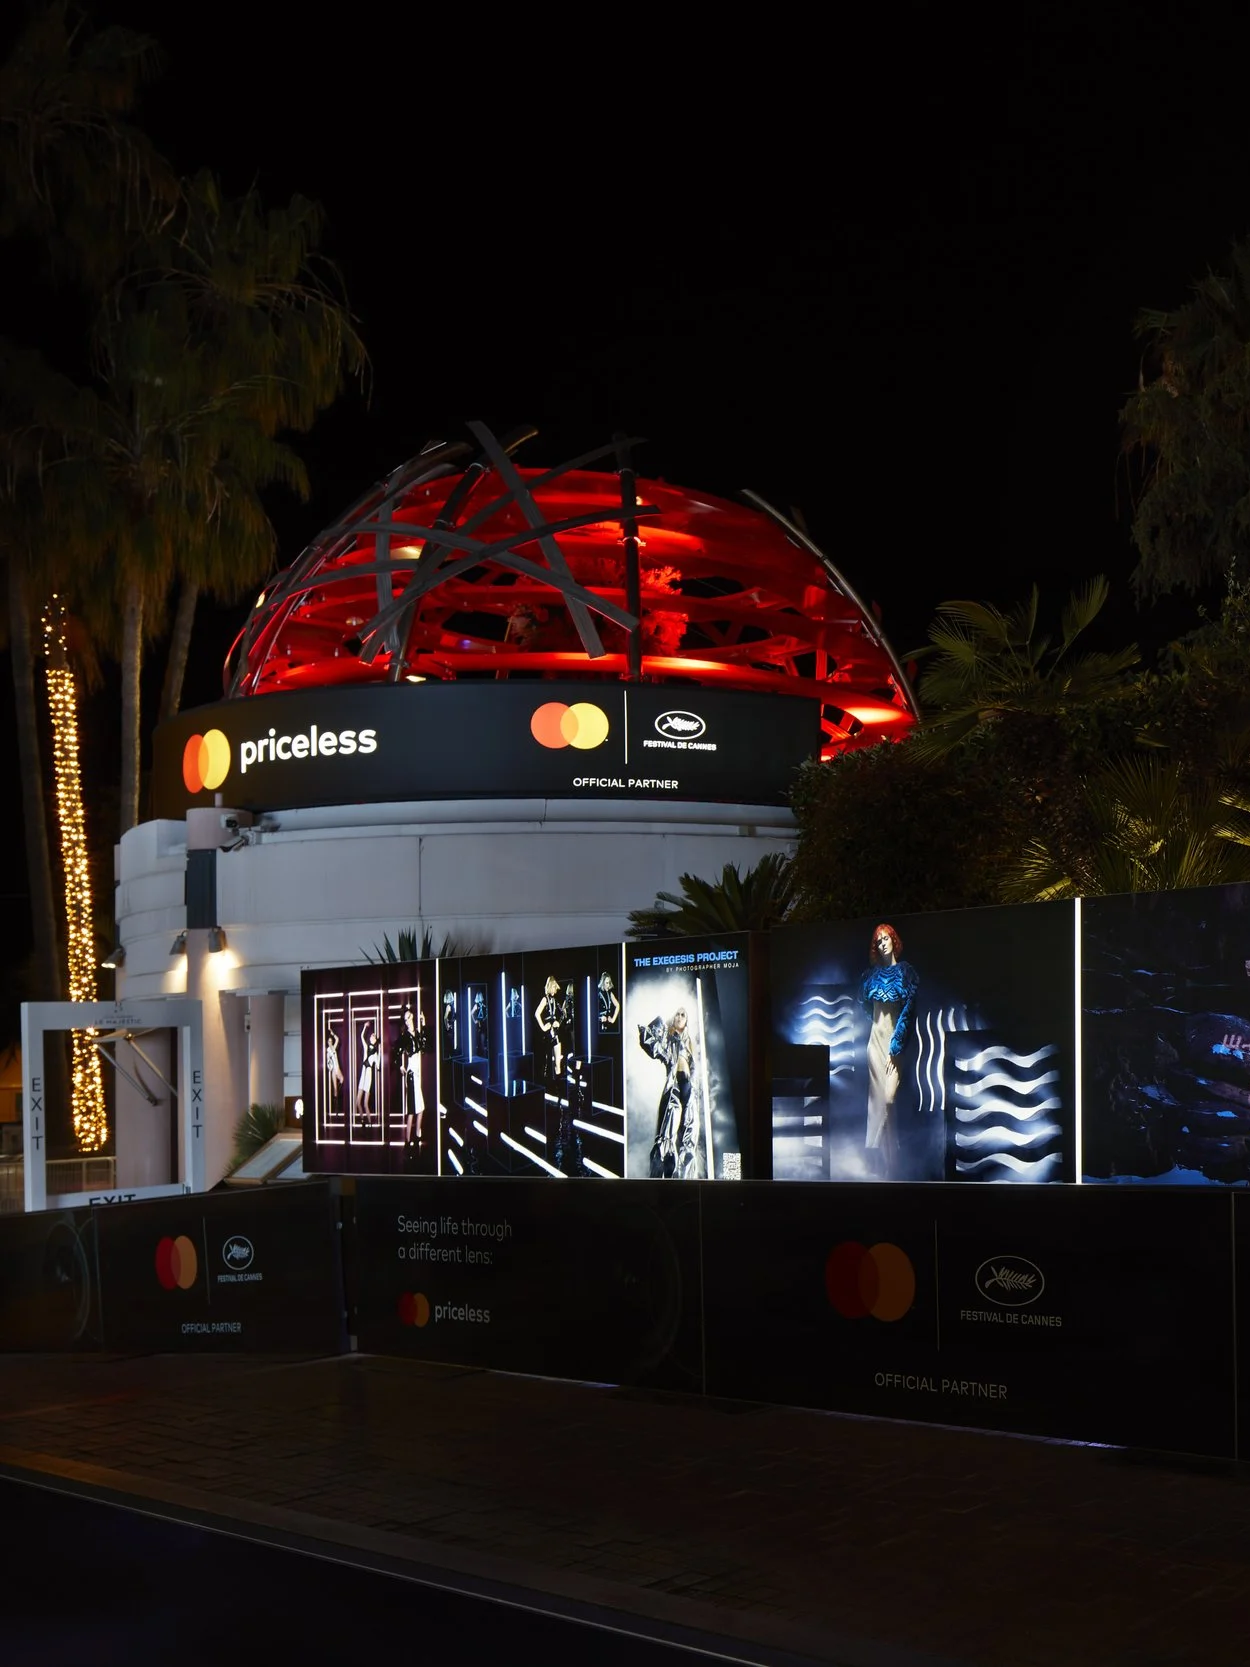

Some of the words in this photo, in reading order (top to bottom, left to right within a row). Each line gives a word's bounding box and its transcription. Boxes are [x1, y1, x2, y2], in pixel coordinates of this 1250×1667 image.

[240, 724, 378, 774] priceless
[643, 740, 676, 749] FESTIVAL
[677, 741, 688, 749] DE
[689, 742, 717, 751] CANNES
[573, 777, 626, 788] OFFICIAL
[628, 779, 679, 789] PARTNER
[634, 958, 651, 967] THE
[652, 954, 695, 966] EXEGESIS
[697, 950, 739, 962] PROJECT
[675, 964, 721, 972] PHOTOGRAPHER
[31, 1077, 43, 1150] EXIT
[192, 1070, 203, 1138] EXIT
[397, 1215, 438, 1239] Seeing
[440, 1216, 459, 1235] life
[461, 1217, 512, 1242] through
[397, 1246, 406, 1259] a
[408, 1242, 463, 1263] different
[465, 1244, 493, 1265] lens:
[217, 1274, 237, 1283] FESTIVAL
[237, 1273, 244, 1282] DE
[244, 1272, 263, 1281] CANNES
[435, 1301, 491, 1324] priceless
[960, 1310, 1005, 1324] FESTIVAL
[1005, 1313, 1019, 1325] DE
[1020, 1314, 1062, 1327] CANNES
[181, 1323, 211, 1334] OFFICIAL
[211, 1322, 242, 1333] PARTNER
[874, 1372, 938, 1393] OFFICIAL
[941, 1379, 1008, 1400] PARTNER
